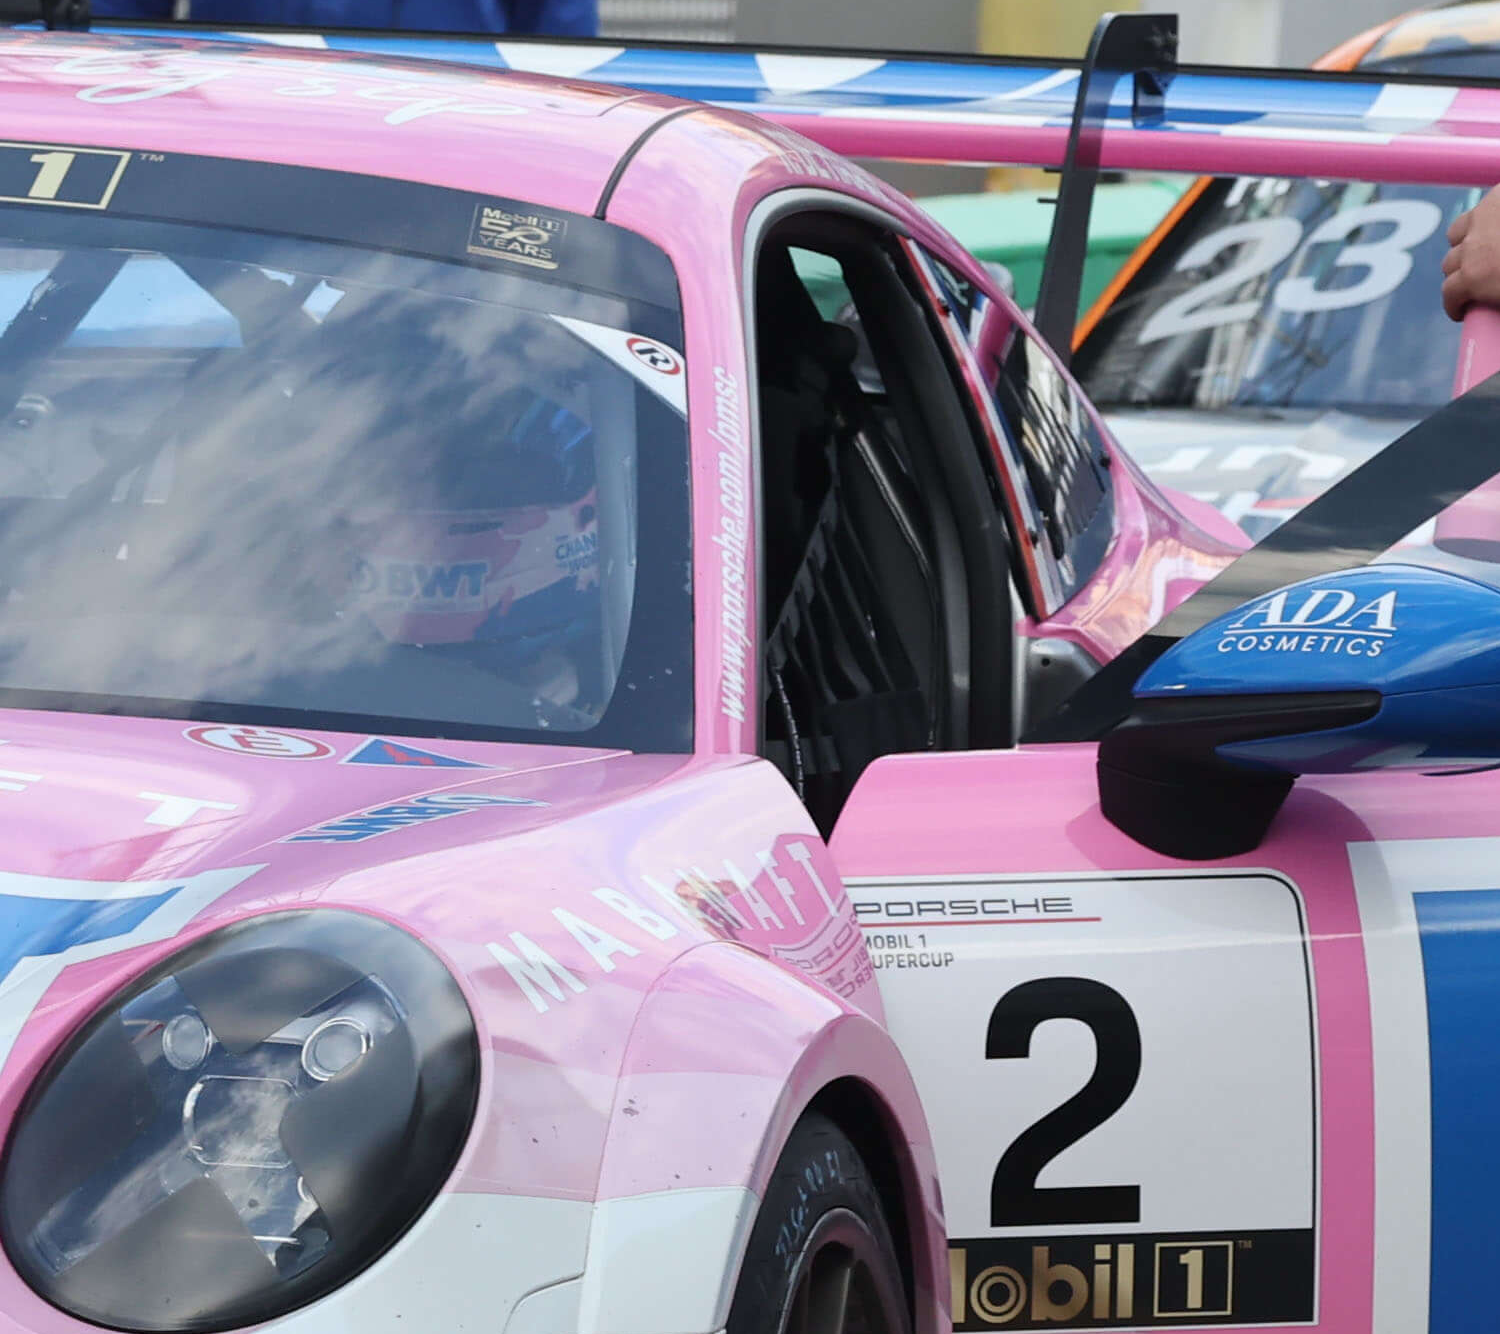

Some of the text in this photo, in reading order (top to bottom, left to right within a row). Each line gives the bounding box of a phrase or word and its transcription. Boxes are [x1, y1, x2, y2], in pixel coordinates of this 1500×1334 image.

[483, 207, 538, 227] Mobil
[478, 234, 553, 260] YEARS
[1138, 198, 1442, 346] 23
[707, 366, 751, 723] www.porsche.com/pmsc
[1228, 588, 1398, 631] ADA
[1217, 634, 1383, 657] COSMETICS
[852, 896, 1076, 918] PORSCHE
[918, 934, 928, 949] 1
[985, 976, 1143, 1228] 2
[950, 1243, 1135, 1324] obil
